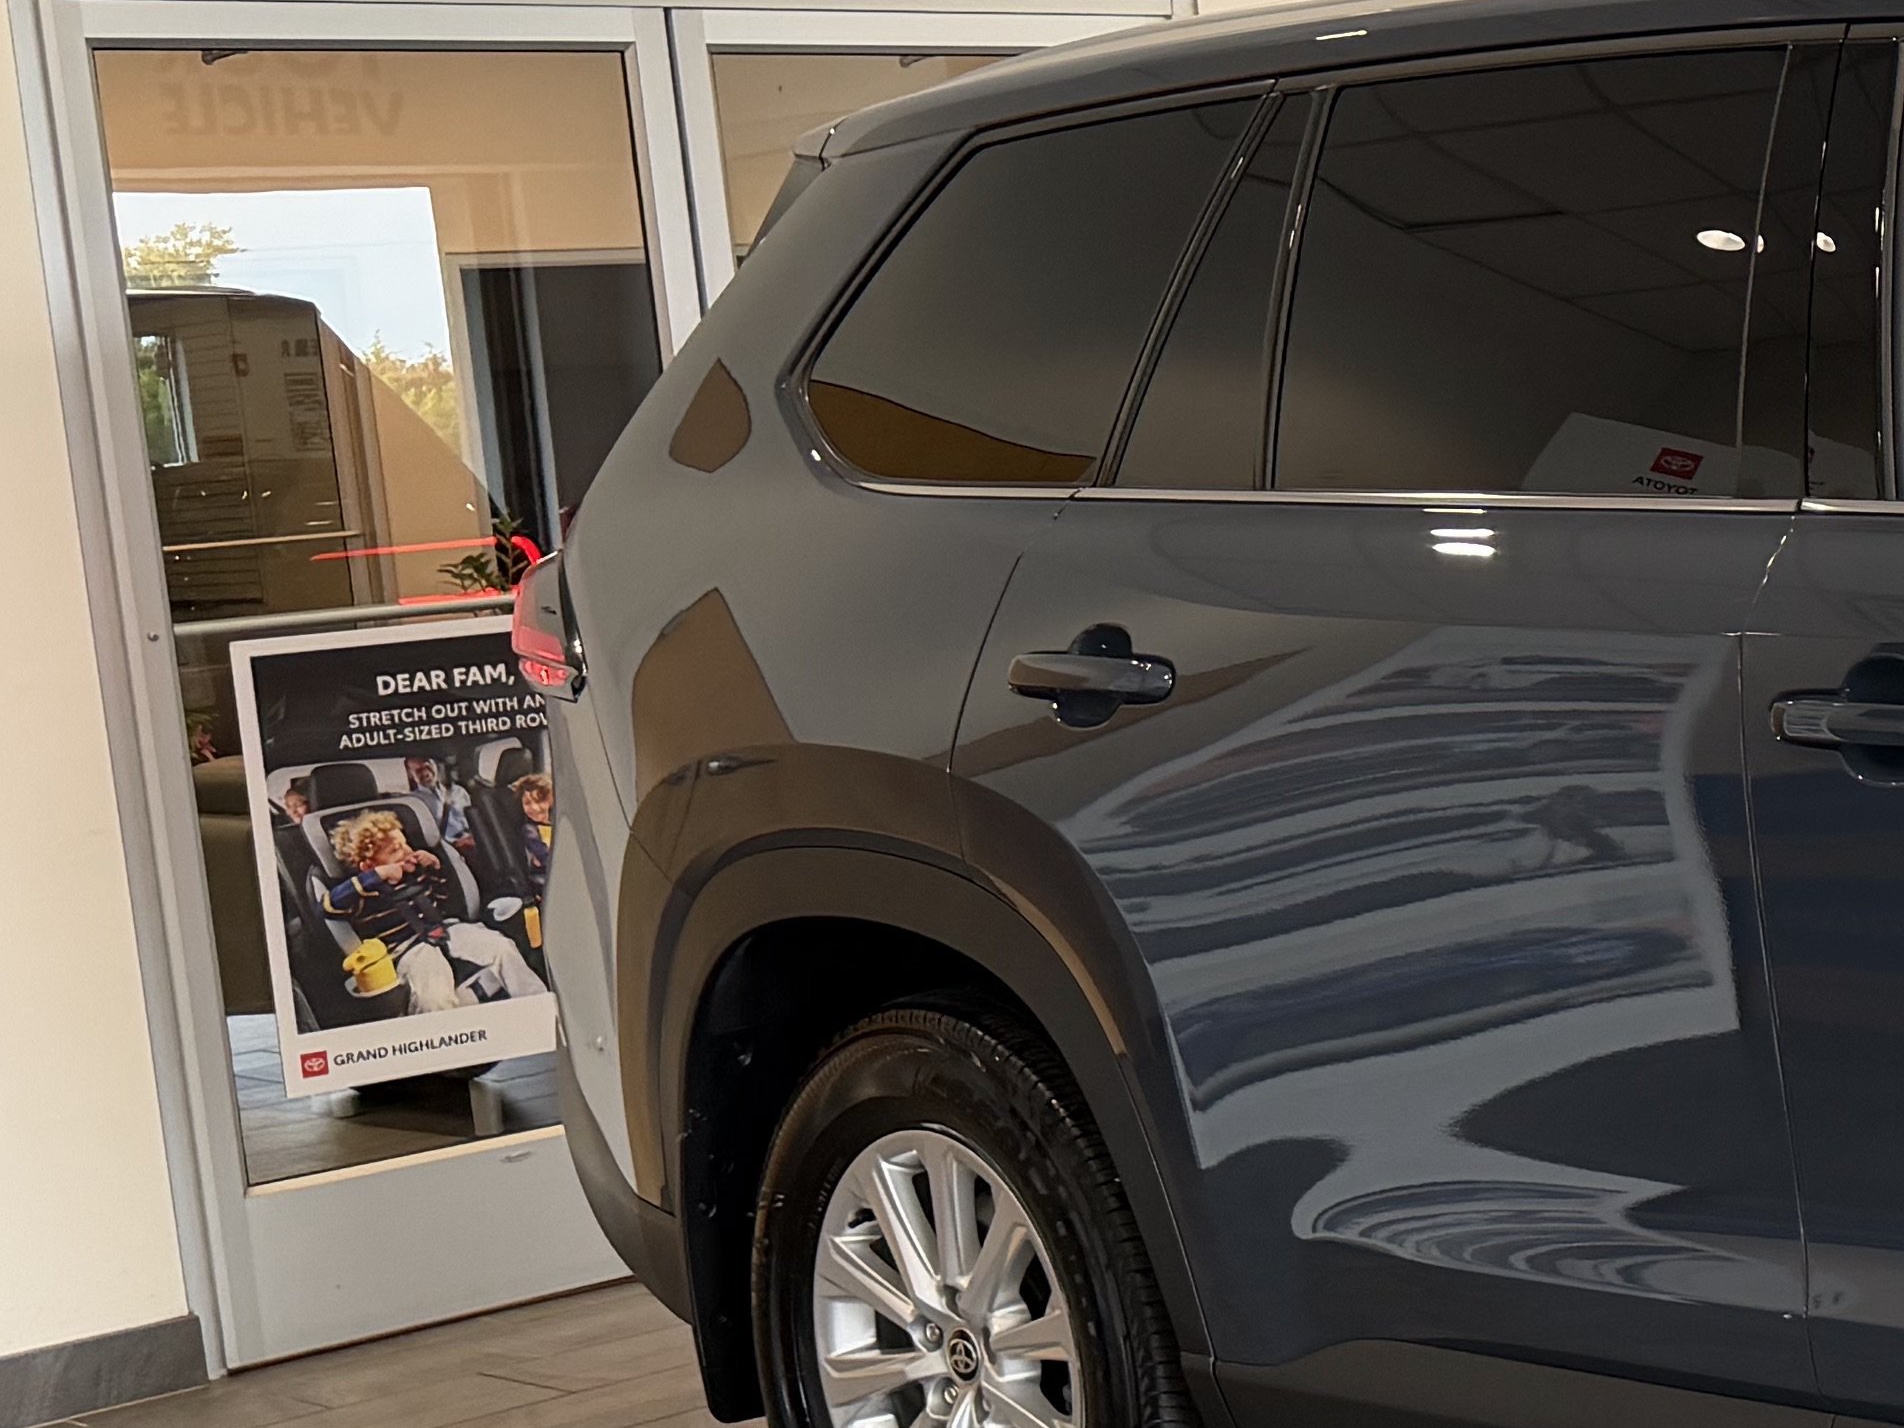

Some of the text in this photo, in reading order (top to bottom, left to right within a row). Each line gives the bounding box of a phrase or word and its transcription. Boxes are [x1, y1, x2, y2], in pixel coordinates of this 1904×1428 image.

[376, 663, 515, 696] DEAR FAM,
[349, 706, 427, 728] STRETCH
[431, 701, 470, 718] OUT
[473, 697, 518, 714] WITH
[339, 722, 454, 750] ADULT-SIZED
[458, 716, 510, 735] THIRD
[333, 1029, 487, 1066] GRAND HIGHLANDER
